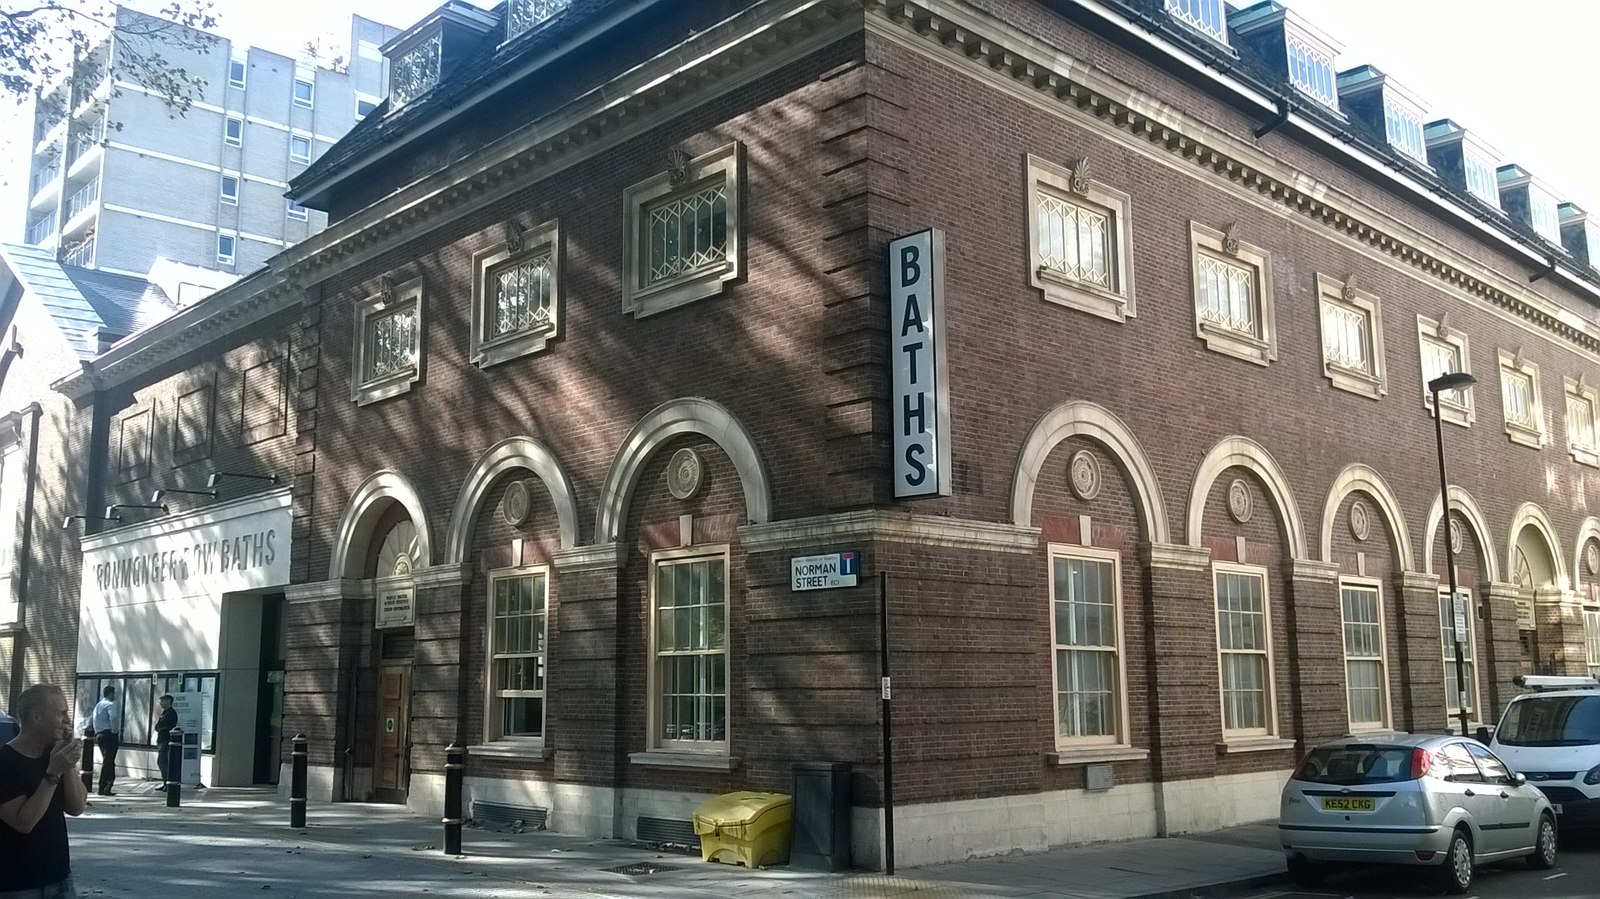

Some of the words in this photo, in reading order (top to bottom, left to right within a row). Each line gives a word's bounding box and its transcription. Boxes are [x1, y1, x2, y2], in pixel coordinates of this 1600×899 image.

[900, 245, 926, 487] BATHS
[93, 549, 177, 591] RONMONGER
[220, 529, 276, 573] BATHS
[795, 563, 836, 576] NORMAN
[796, 576, 828, 588] STREET
[1325, 799, 1349, 809] KE52
[1351, 800, 1371, 809] CKG
